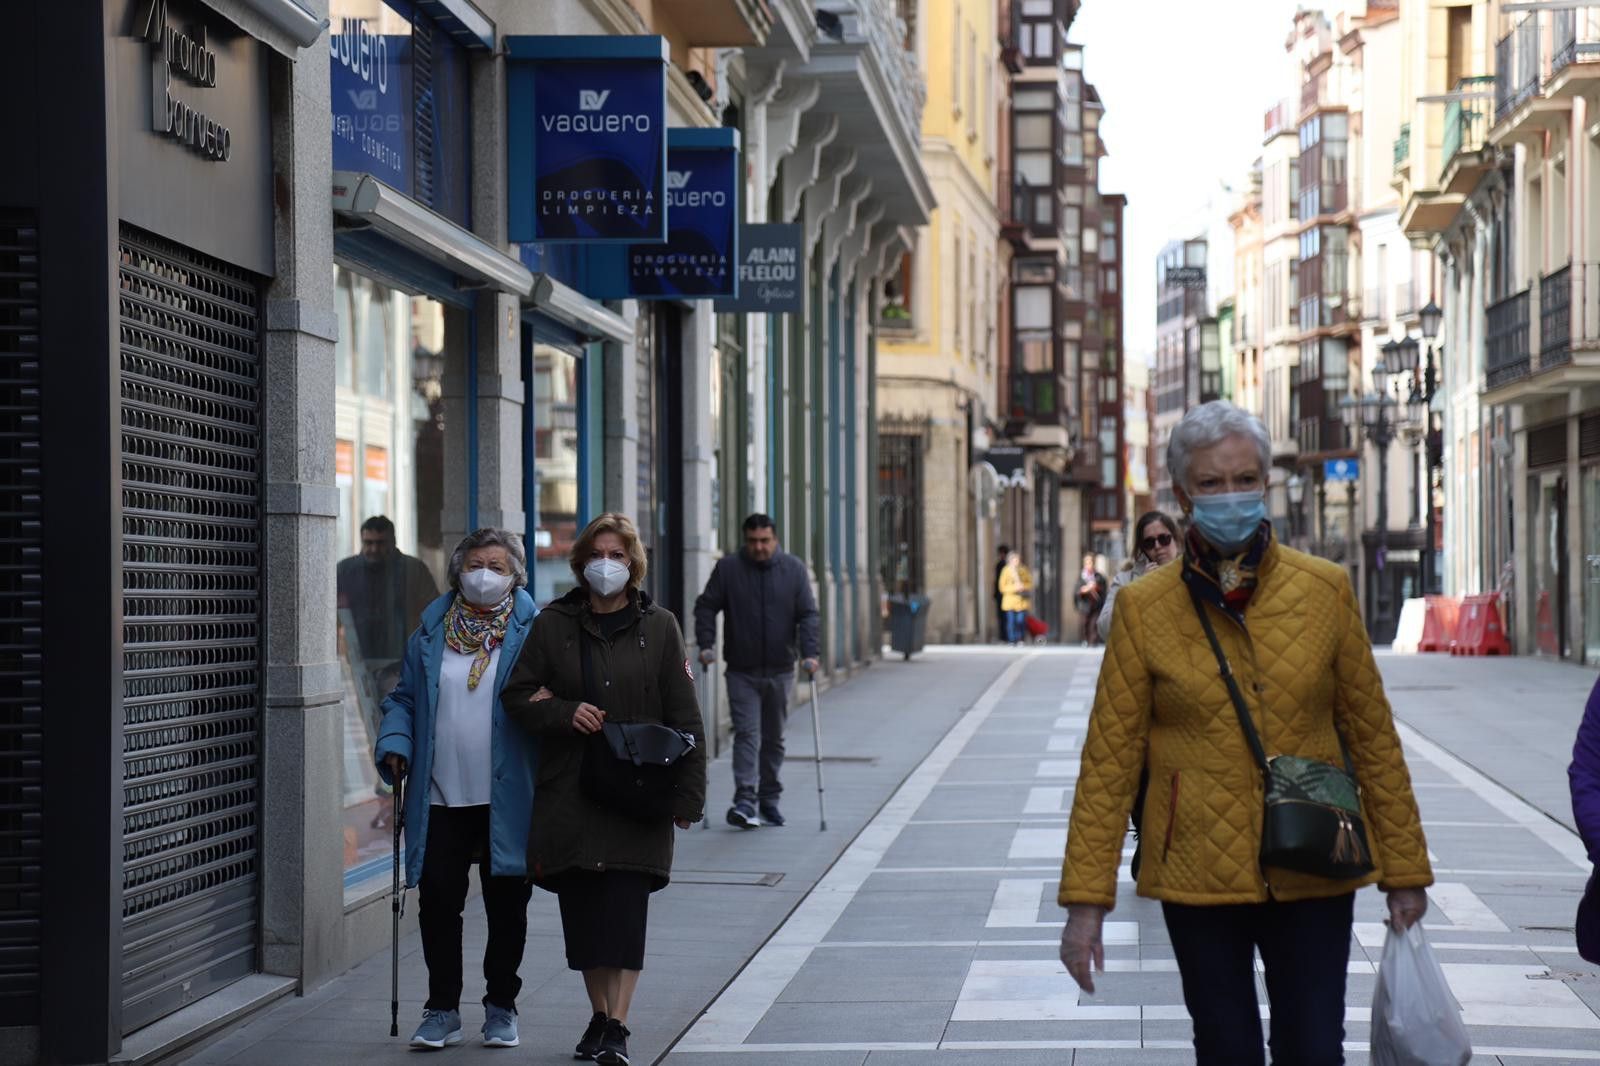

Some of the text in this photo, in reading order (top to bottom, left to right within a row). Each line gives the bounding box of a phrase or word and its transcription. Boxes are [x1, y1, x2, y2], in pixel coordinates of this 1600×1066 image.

[144, 0, 217, 88] Miranda
[164, 60, 232, 161] Barrueco
[543, 189, 654, 201] DROGUERÍA
[542, 205, 654, 215] LIMPIEZA
[747, 248, 796, 263] ALAIN
[633, 267, 727, 276] LIMPIEZA
[739, 265, 796, 281] FLELOU
